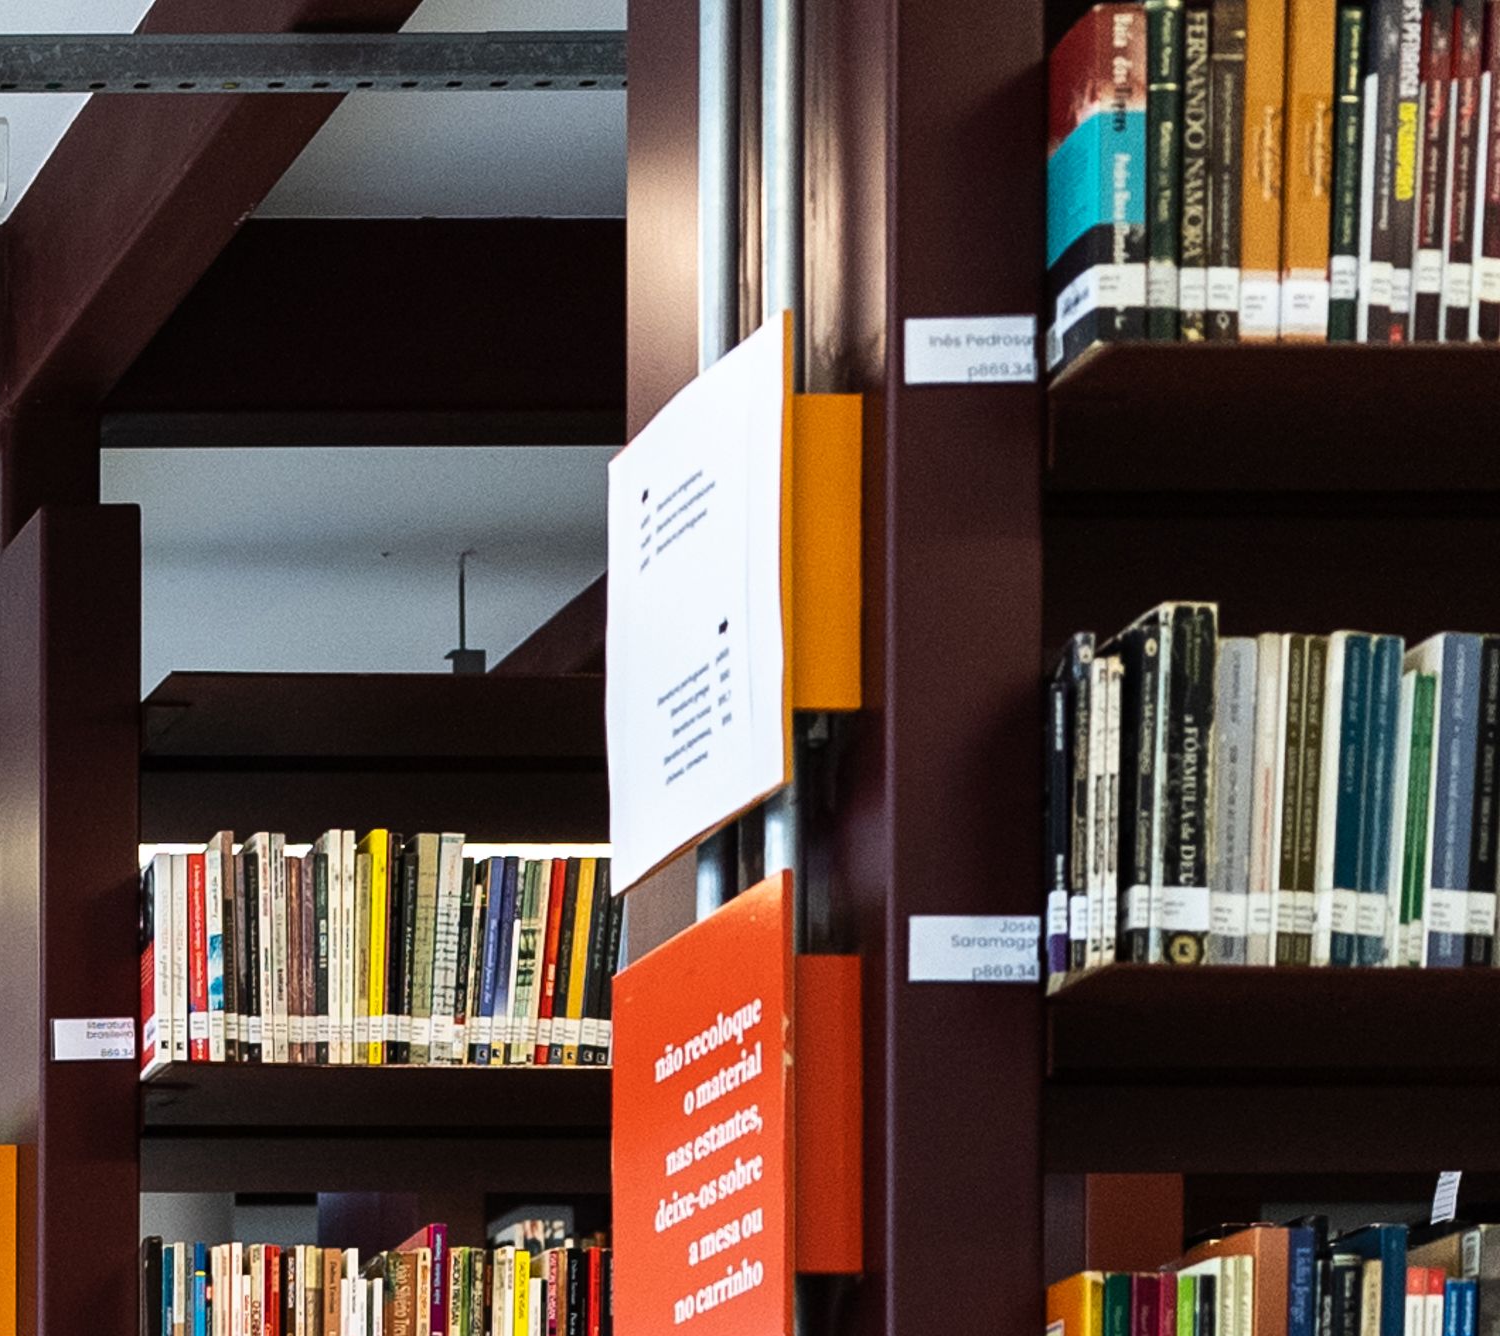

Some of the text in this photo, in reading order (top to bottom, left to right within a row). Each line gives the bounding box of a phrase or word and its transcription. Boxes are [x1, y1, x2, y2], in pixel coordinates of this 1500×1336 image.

[1183, 9, 1209, 260] FERNANDO NAMORA
[929, 334, 961, 347] Inês
[1180, 727, 1201, 820] FÓRMULA
[1181, 823, 1196, 841] de
[1179, 845, 1199, 886] DEU
[999, 921, 1037, 933] José
[654, 997, 762, 1084] não recoloque
[684, 1040, 762, 1116] o material
[666, 1103, 763, 1177] nas estantes,
[654, 1154, 763, 1233] deixe-os sobre
[688, 1207, 763, 1266] a mesa ou
[1296, 1246, 1311, 1281] Lídia
[391, 1284, 409, 1317] Silvério
[392, 1262, 409, 1283] João
[674, 1257, 764, 1325] no carrinho
